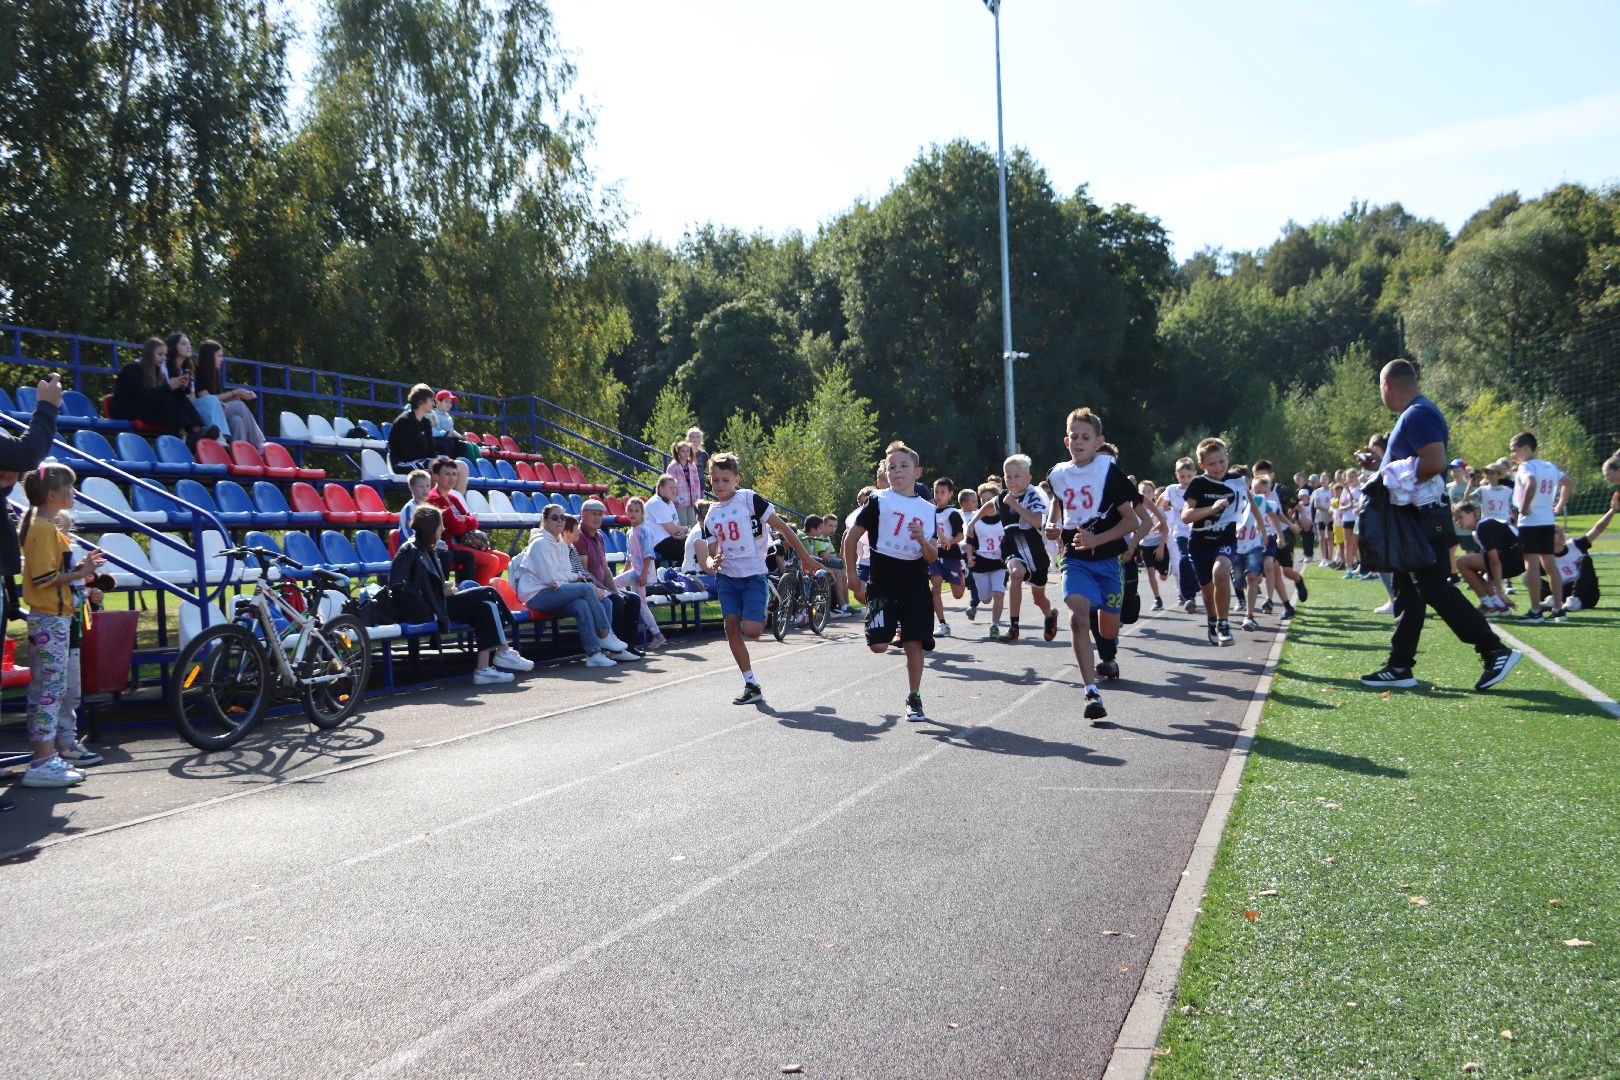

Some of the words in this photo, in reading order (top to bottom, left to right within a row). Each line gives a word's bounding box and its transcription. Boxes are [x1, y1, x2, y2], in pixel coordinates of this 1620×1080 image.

[1063, 485, 1094, 510] 25
[1487, 500, 1503, 511] 57
[714, 520, 741, 541] 38
[1106, 593, 1122, 609] 22
